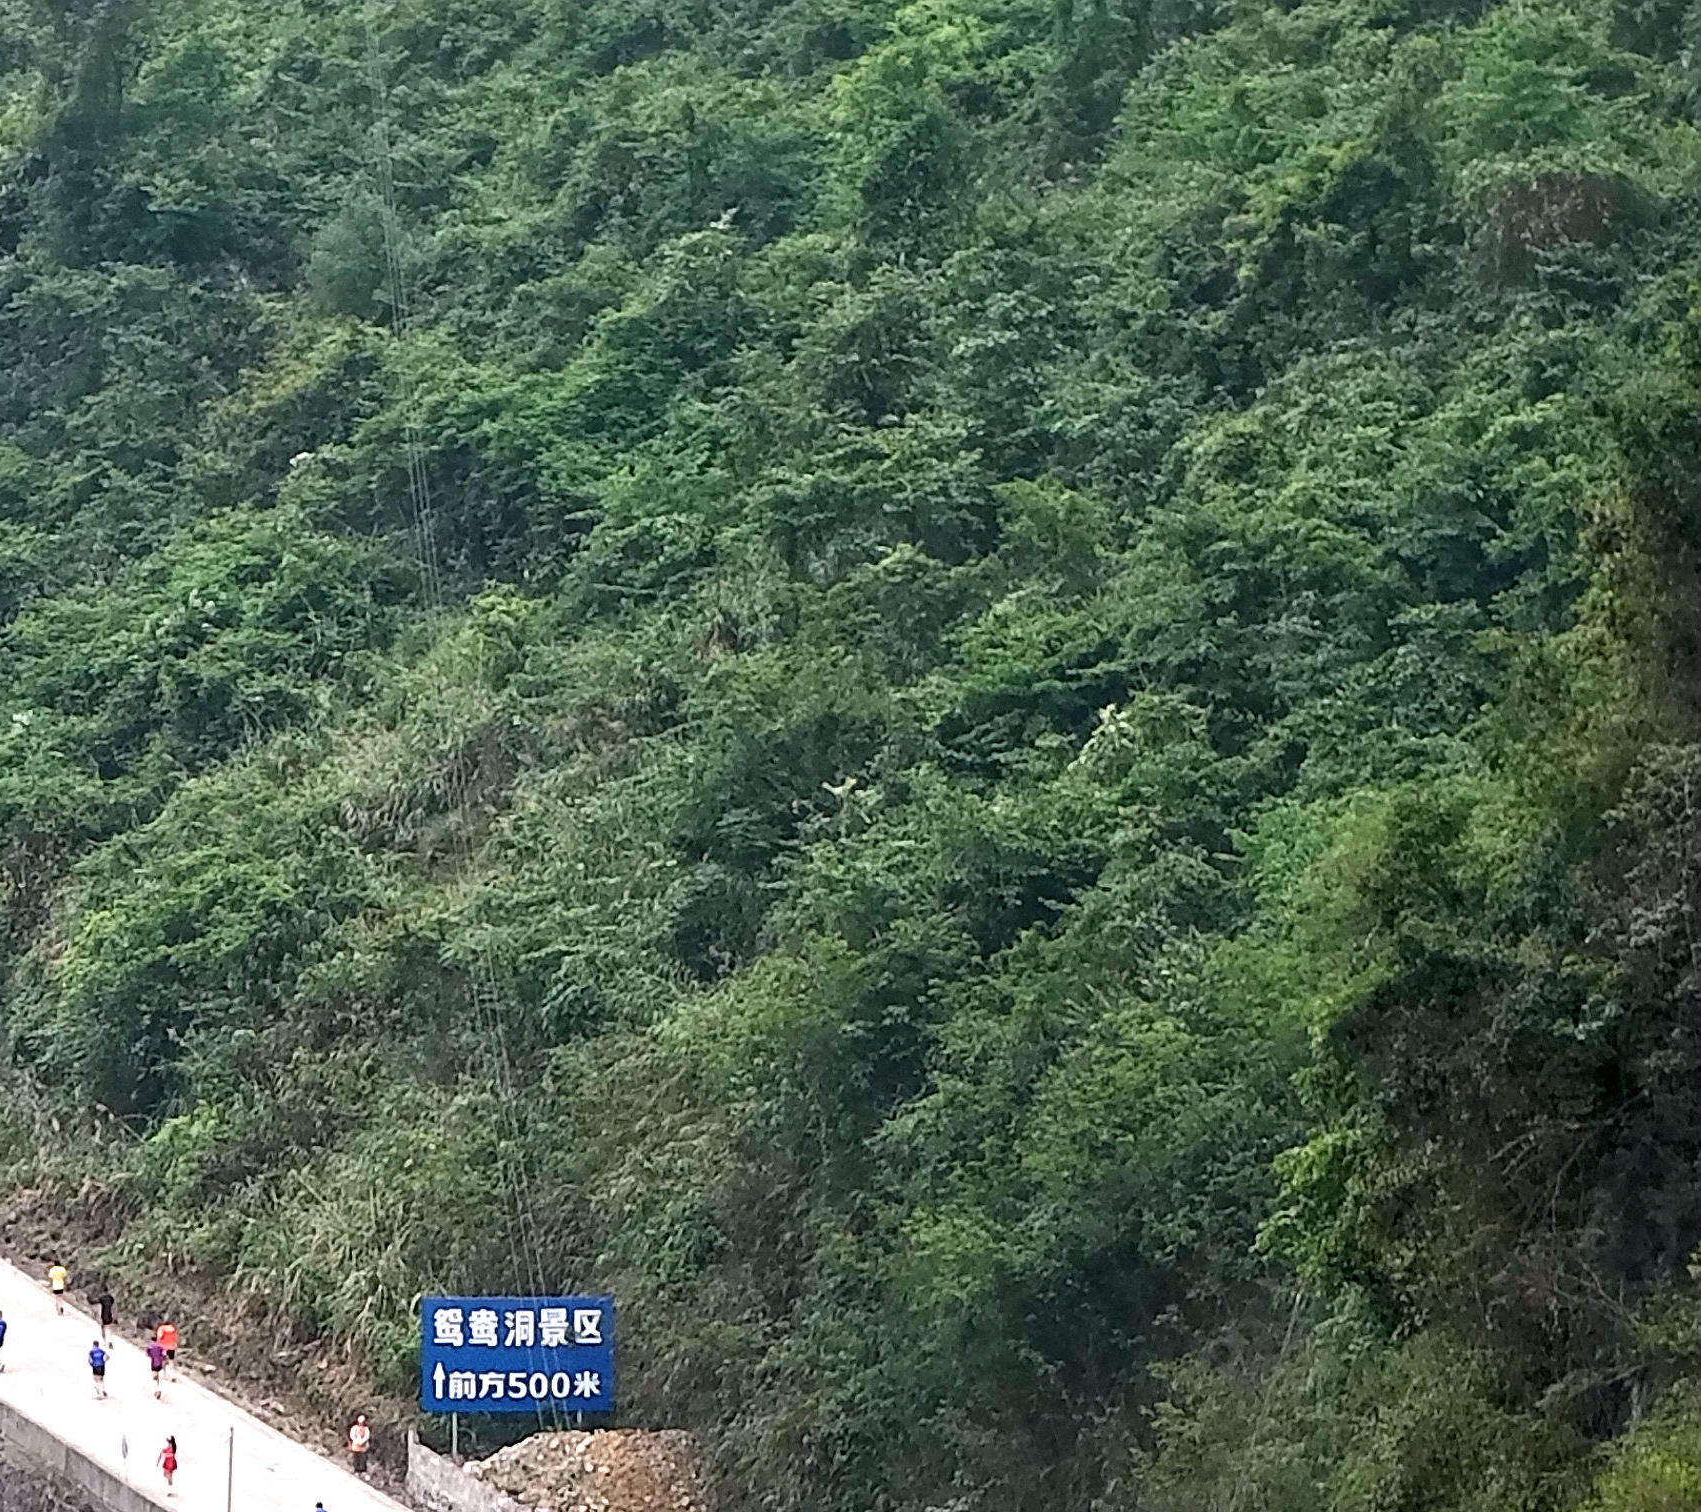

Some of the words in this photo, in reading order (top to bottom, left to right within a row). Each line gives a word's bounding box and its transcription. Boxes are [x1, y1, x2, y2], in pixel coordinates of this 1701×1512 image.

[433, 1307, 603, 1347] 鸳鸯洞景区
[448, 1370, 601, 1400] 前方500米
